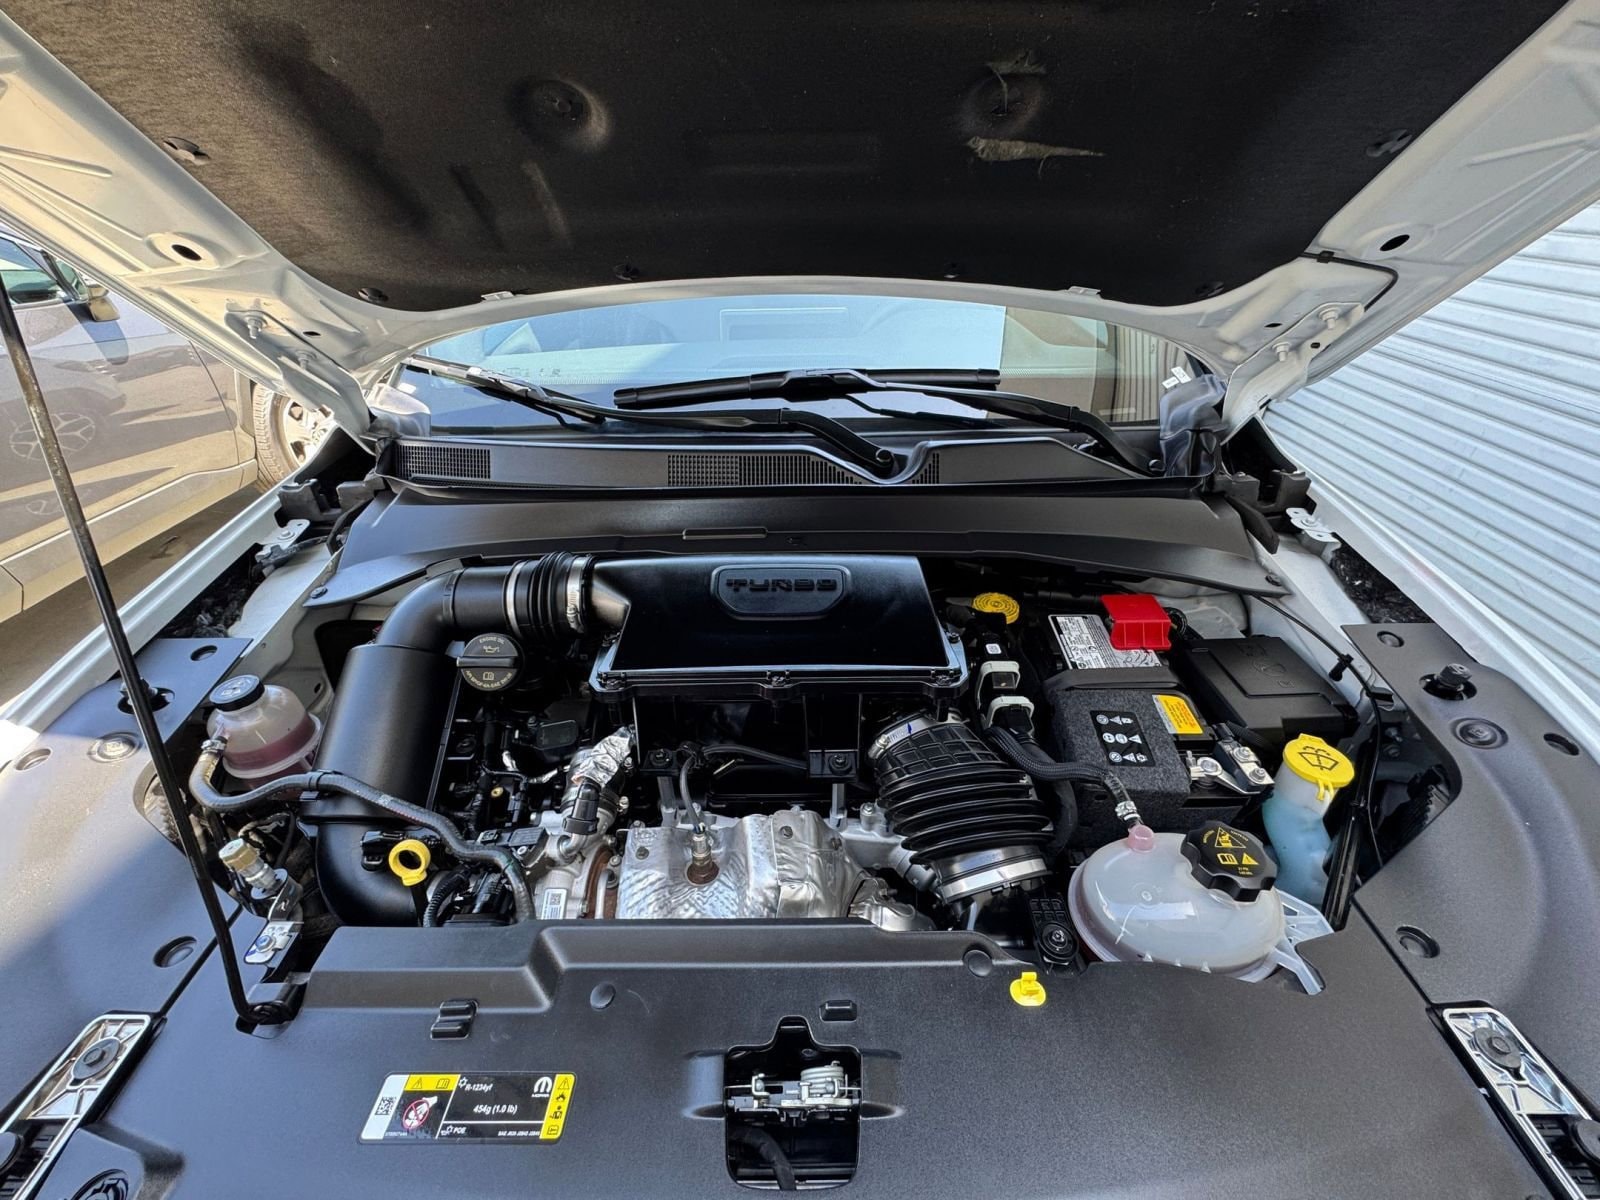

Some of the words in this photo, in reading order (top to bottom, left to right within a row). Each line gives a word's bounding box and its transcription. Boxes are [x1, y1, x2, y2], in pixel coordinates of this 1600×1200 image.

[726, 579, 838, 592] TURBO
[464, 1083, 493, 1092] R-1234yf
[473, 1104, 492, 1115] 454g
[492, 1104, 507, 1115] (1.0
[507, 1104, 518, 1115] lb)
